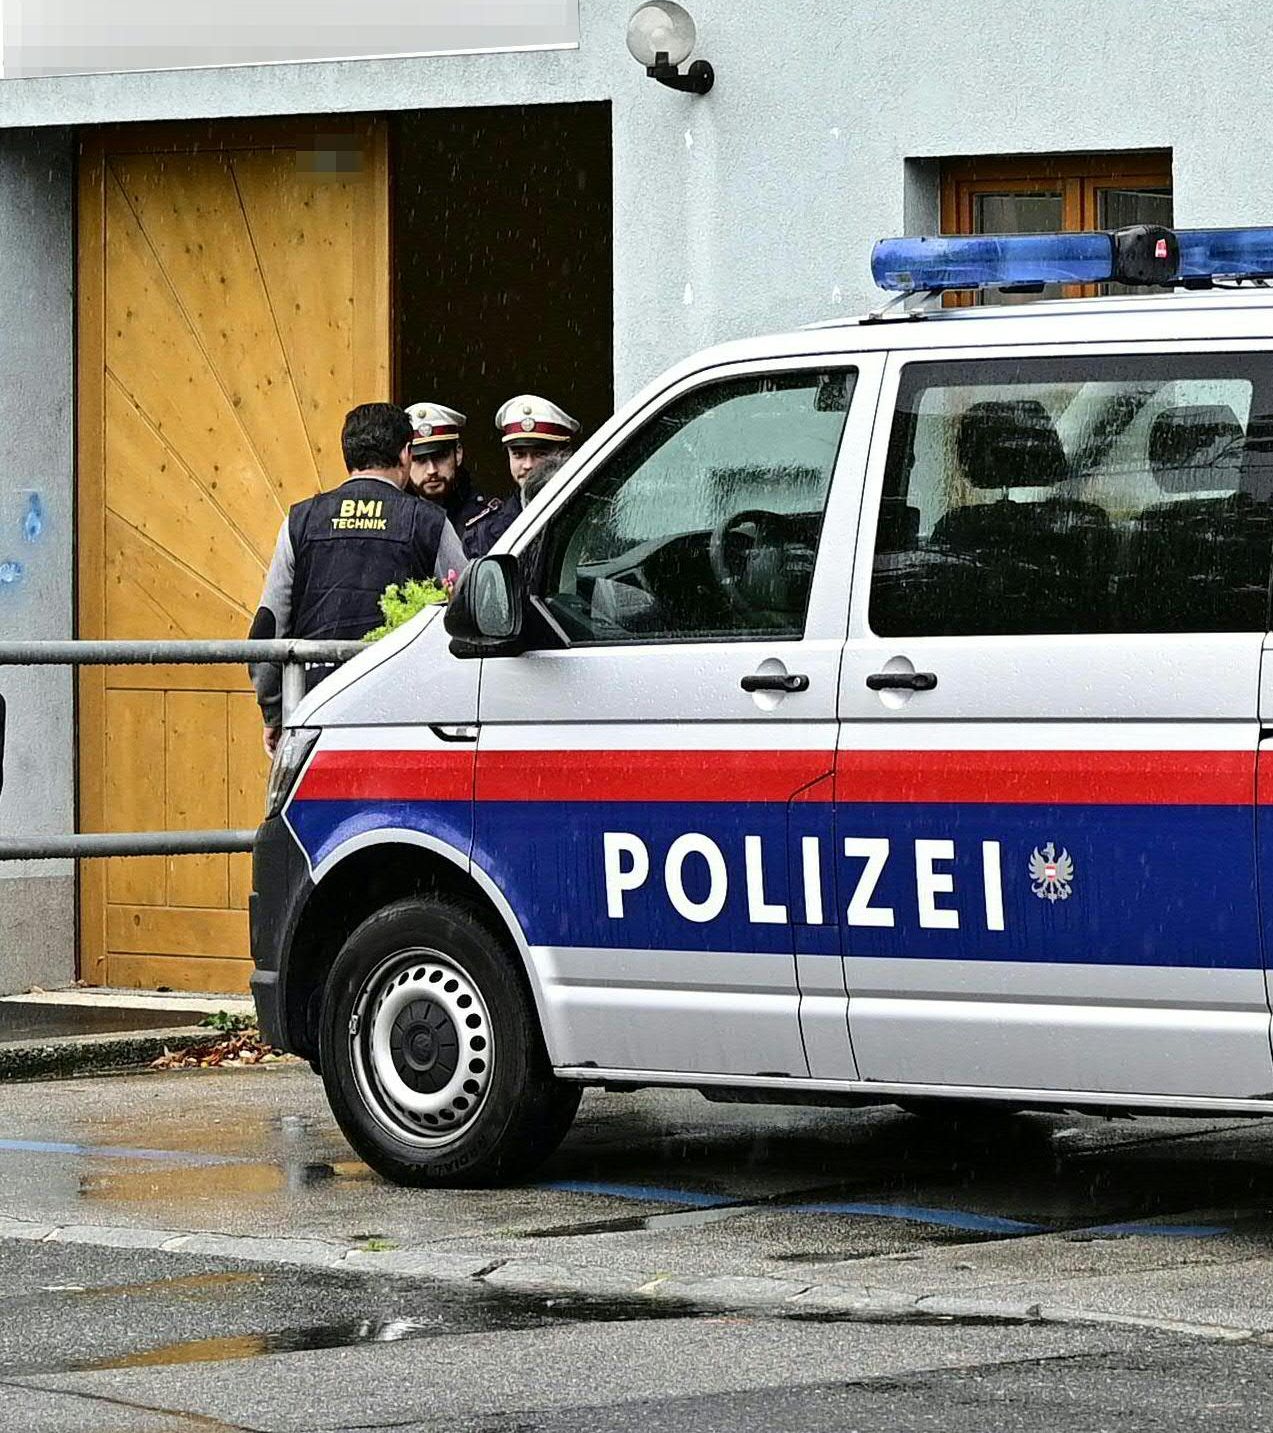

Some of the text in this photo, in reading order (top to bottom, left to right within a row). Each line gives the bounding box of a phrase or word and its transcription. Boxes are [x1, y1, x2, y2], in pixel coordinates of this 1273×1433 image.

[339, 499, 383, 518] BMI
[331, 518, 387, 530] TECHNIK
[603, 832, 1005, 931] POLIZEI
